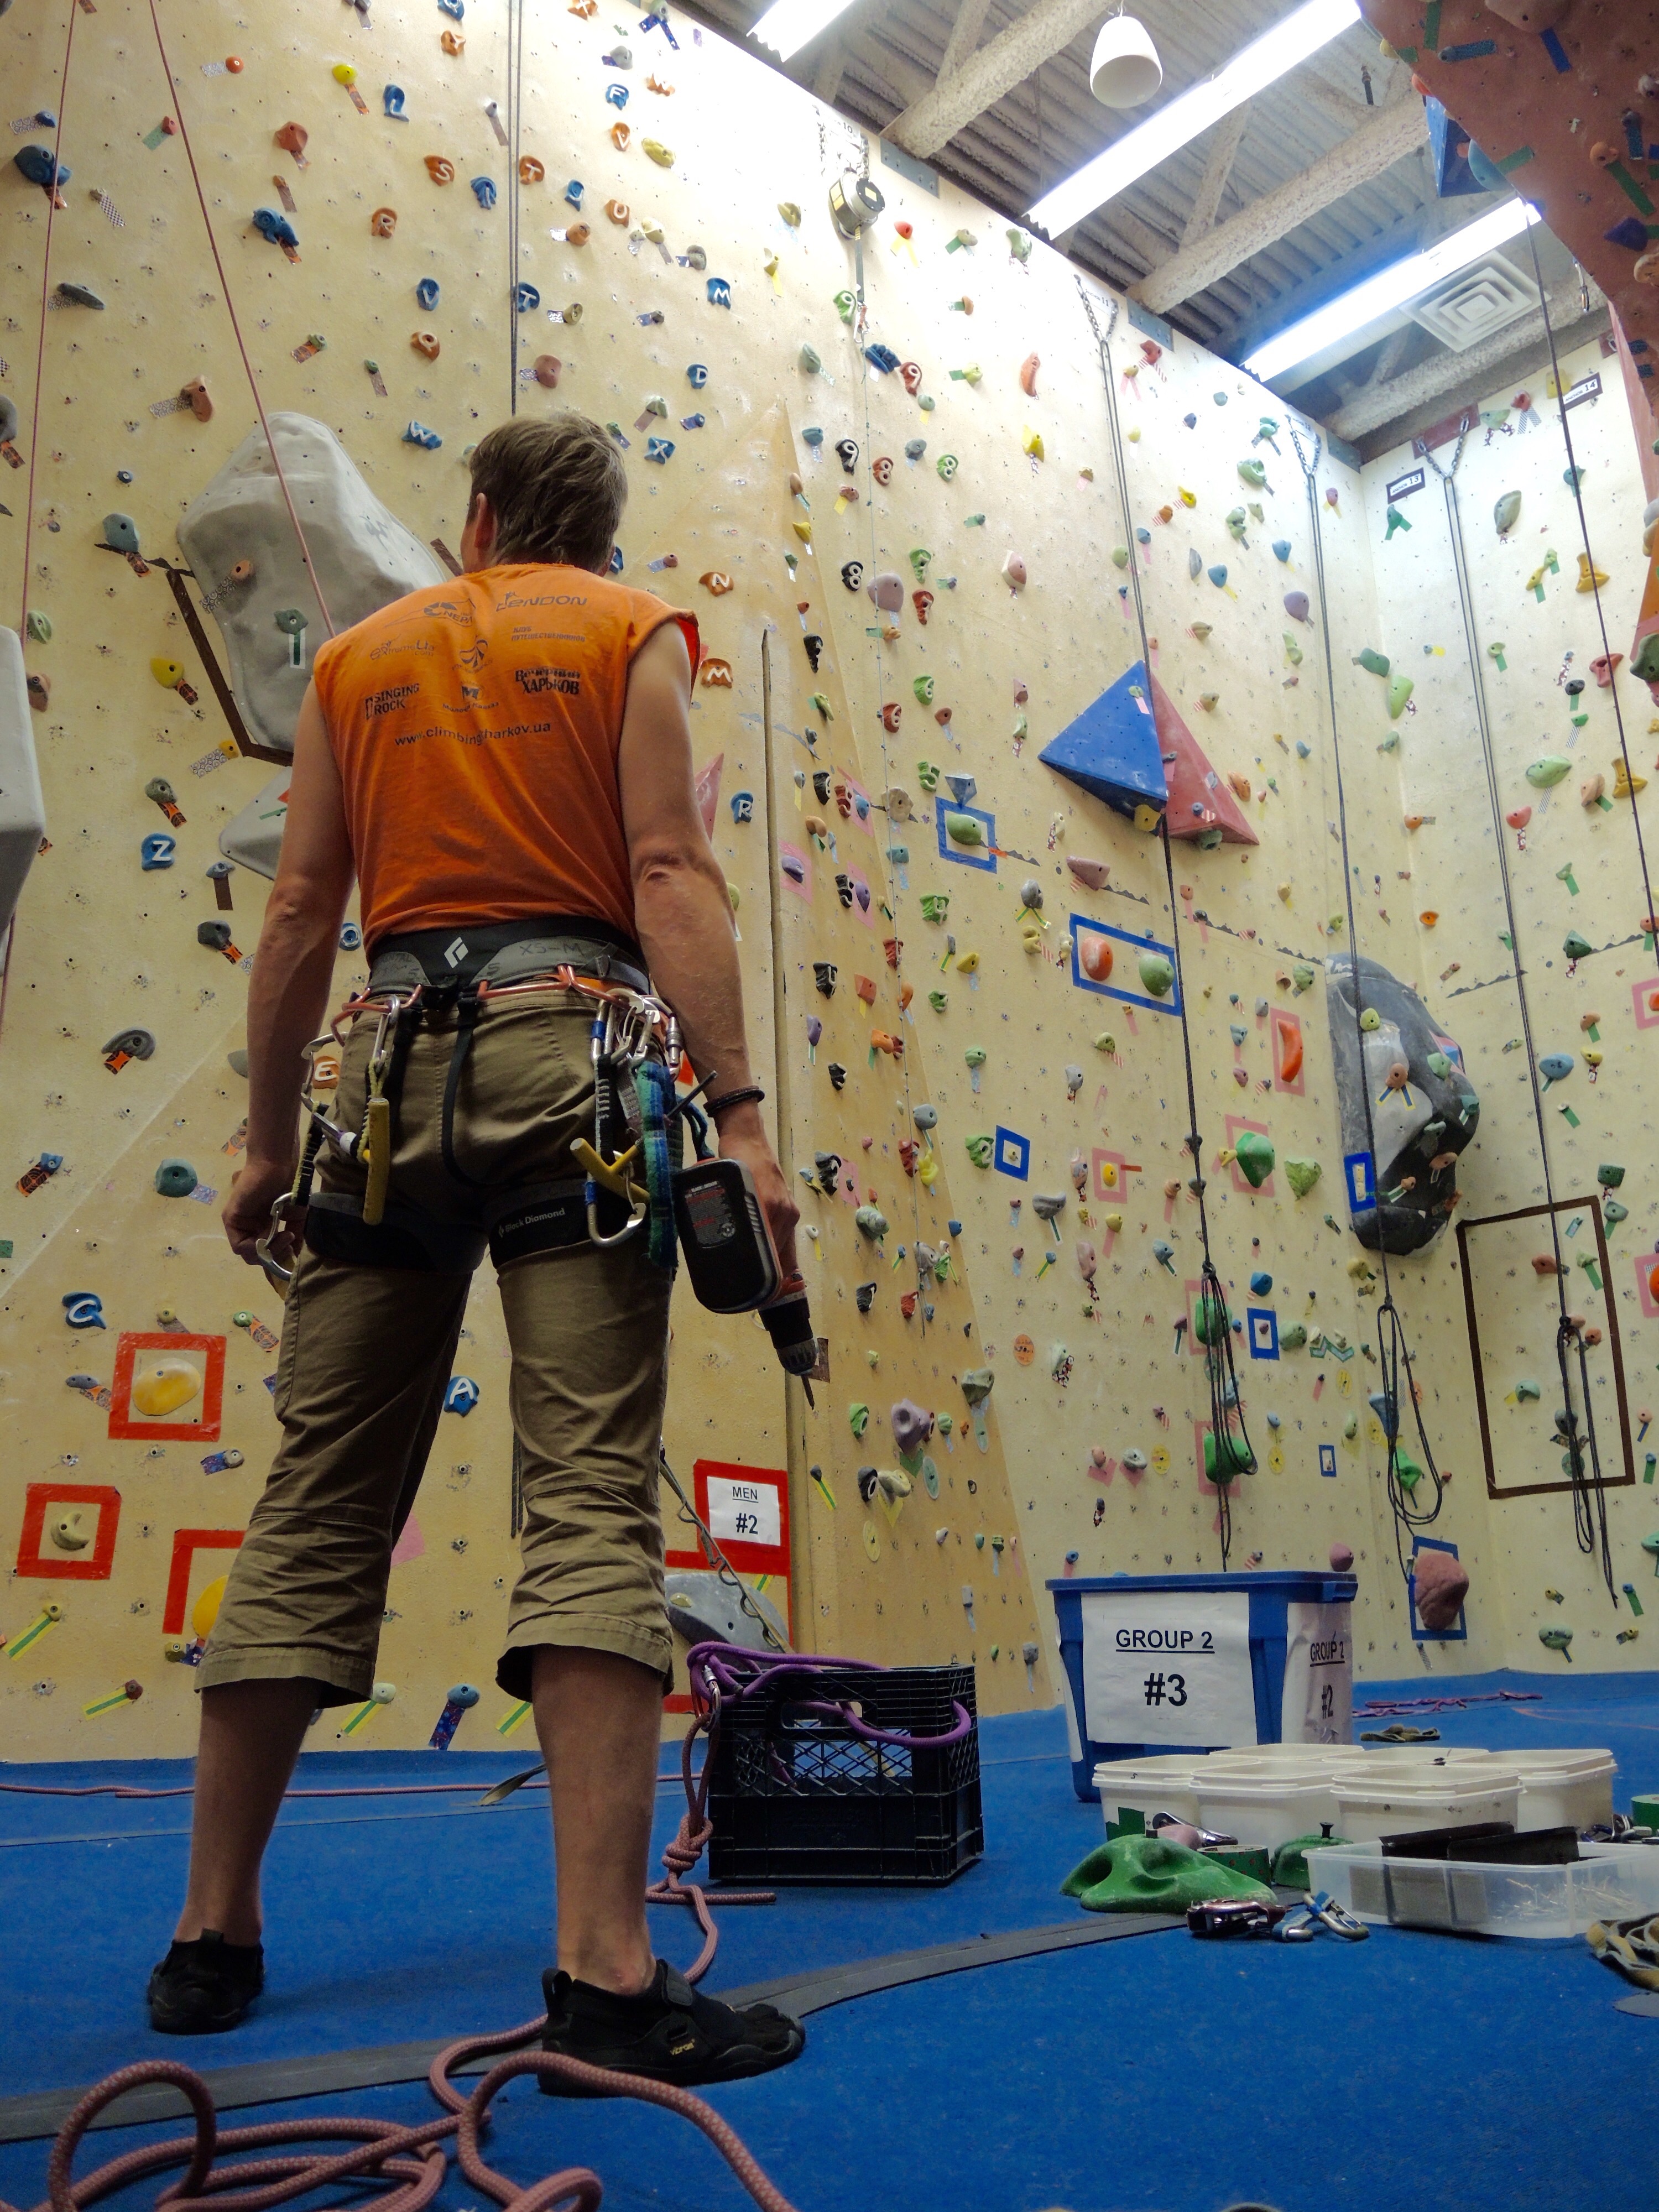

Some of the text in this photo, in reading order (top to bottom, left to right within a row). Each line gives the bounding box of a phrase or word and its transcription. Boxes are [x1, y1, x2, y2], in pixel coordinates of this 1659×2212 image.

[843, 122, 852, 133] 10
[1585, 381, 1596, 392] 14
[1410, 475, 1420, 484] 13
[374, 683, 420, 703] SINGING
[523, 677, 580, 695] ХАРЬКОВ
[374, 699, 406, 715] ROCK
[525, 1208, 565, 1224] Diamond
[732, 1486, 758, 1500] MEN
[736, 1512, 758, 1535] #2
[1116, 1629, 1213, 1649] GROUP 2
[1310, 1641, 1344, 1662] GROUP 2
[1144, 1672, 1187, 1707] #3
[1321, 1684, 1334, 1719] #2
